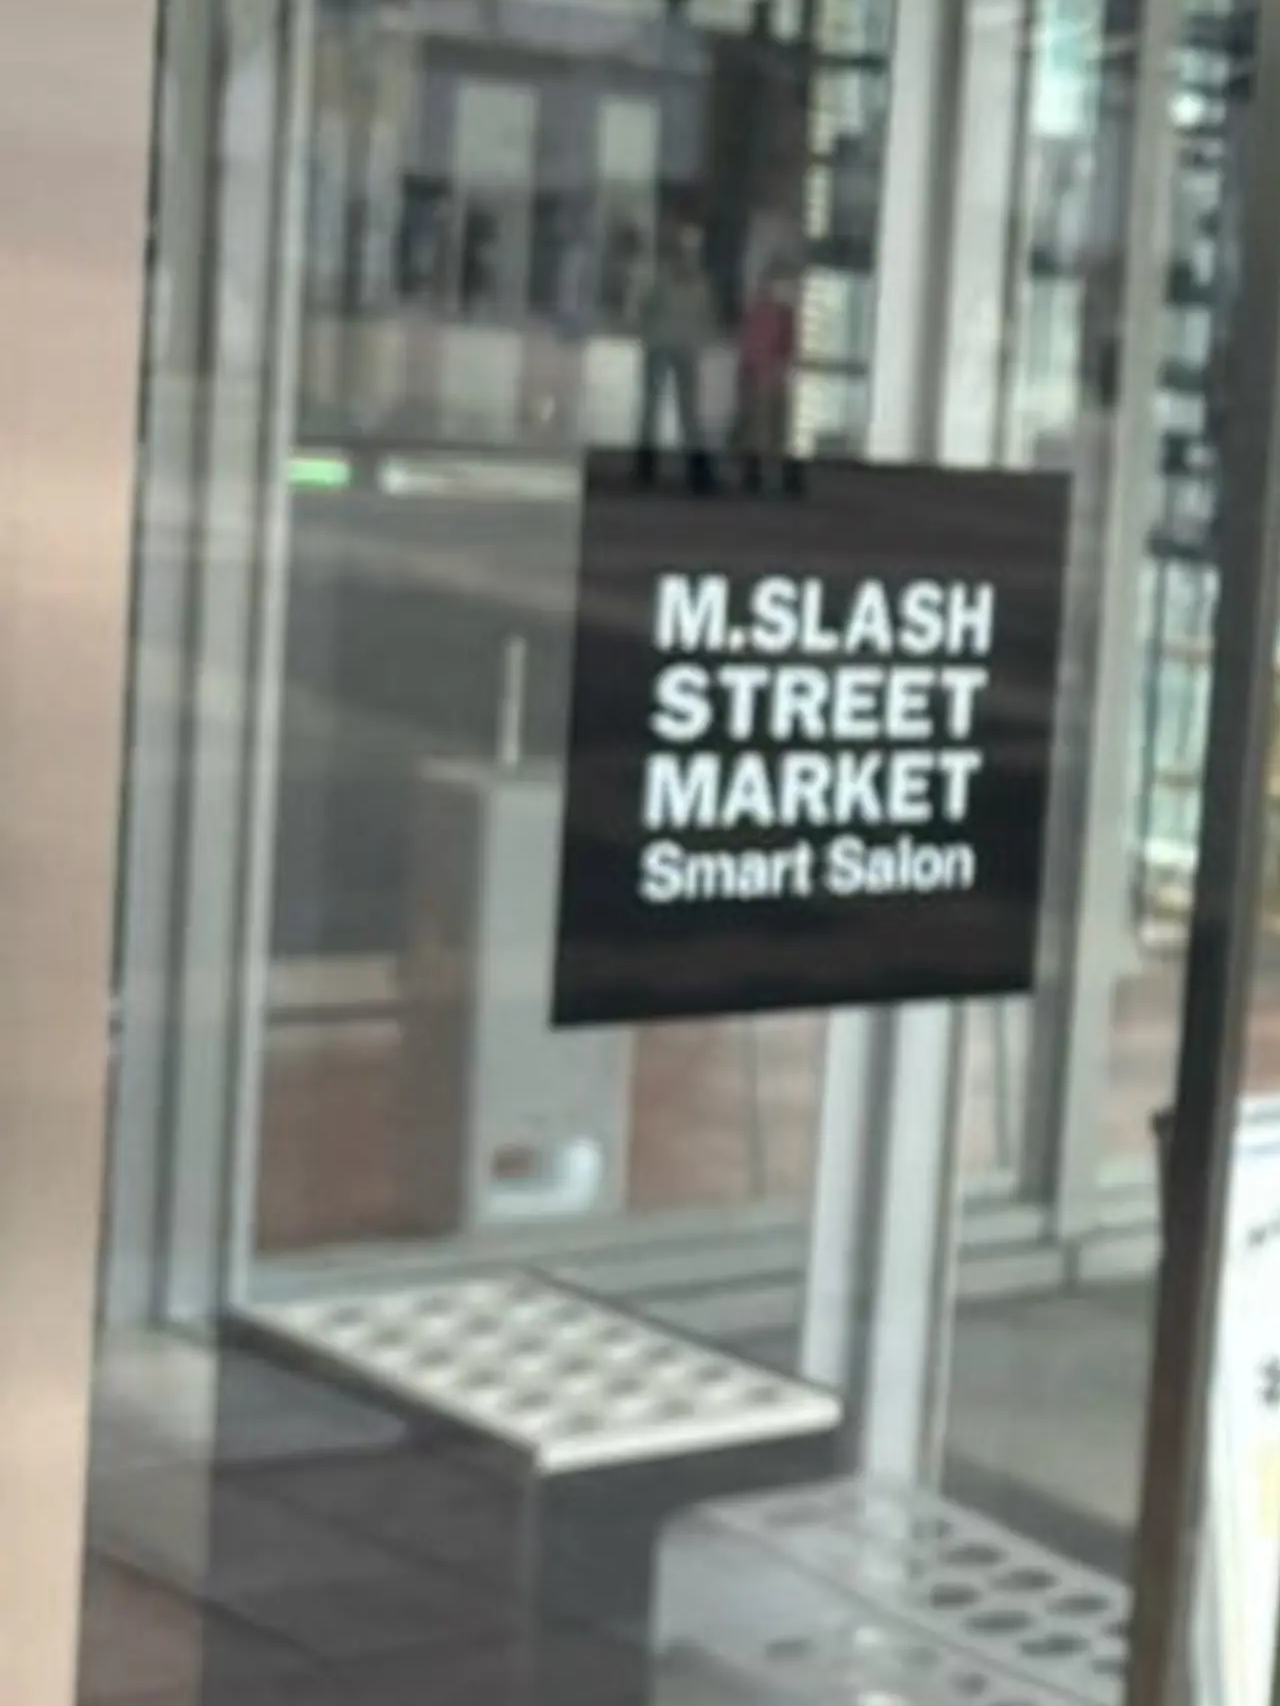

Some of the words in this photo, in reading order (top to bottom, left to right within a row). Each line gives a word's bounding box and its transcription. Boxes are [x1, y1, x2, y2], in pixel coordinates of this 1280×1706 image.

[655, 573, 995, 655] M.SLASH
[648, 663, 989, 741] STREET
[641, 749, 983, 830] MARKET
[638, 837, 814, 903] Smart
[823, 834, 976, 895] Salon
